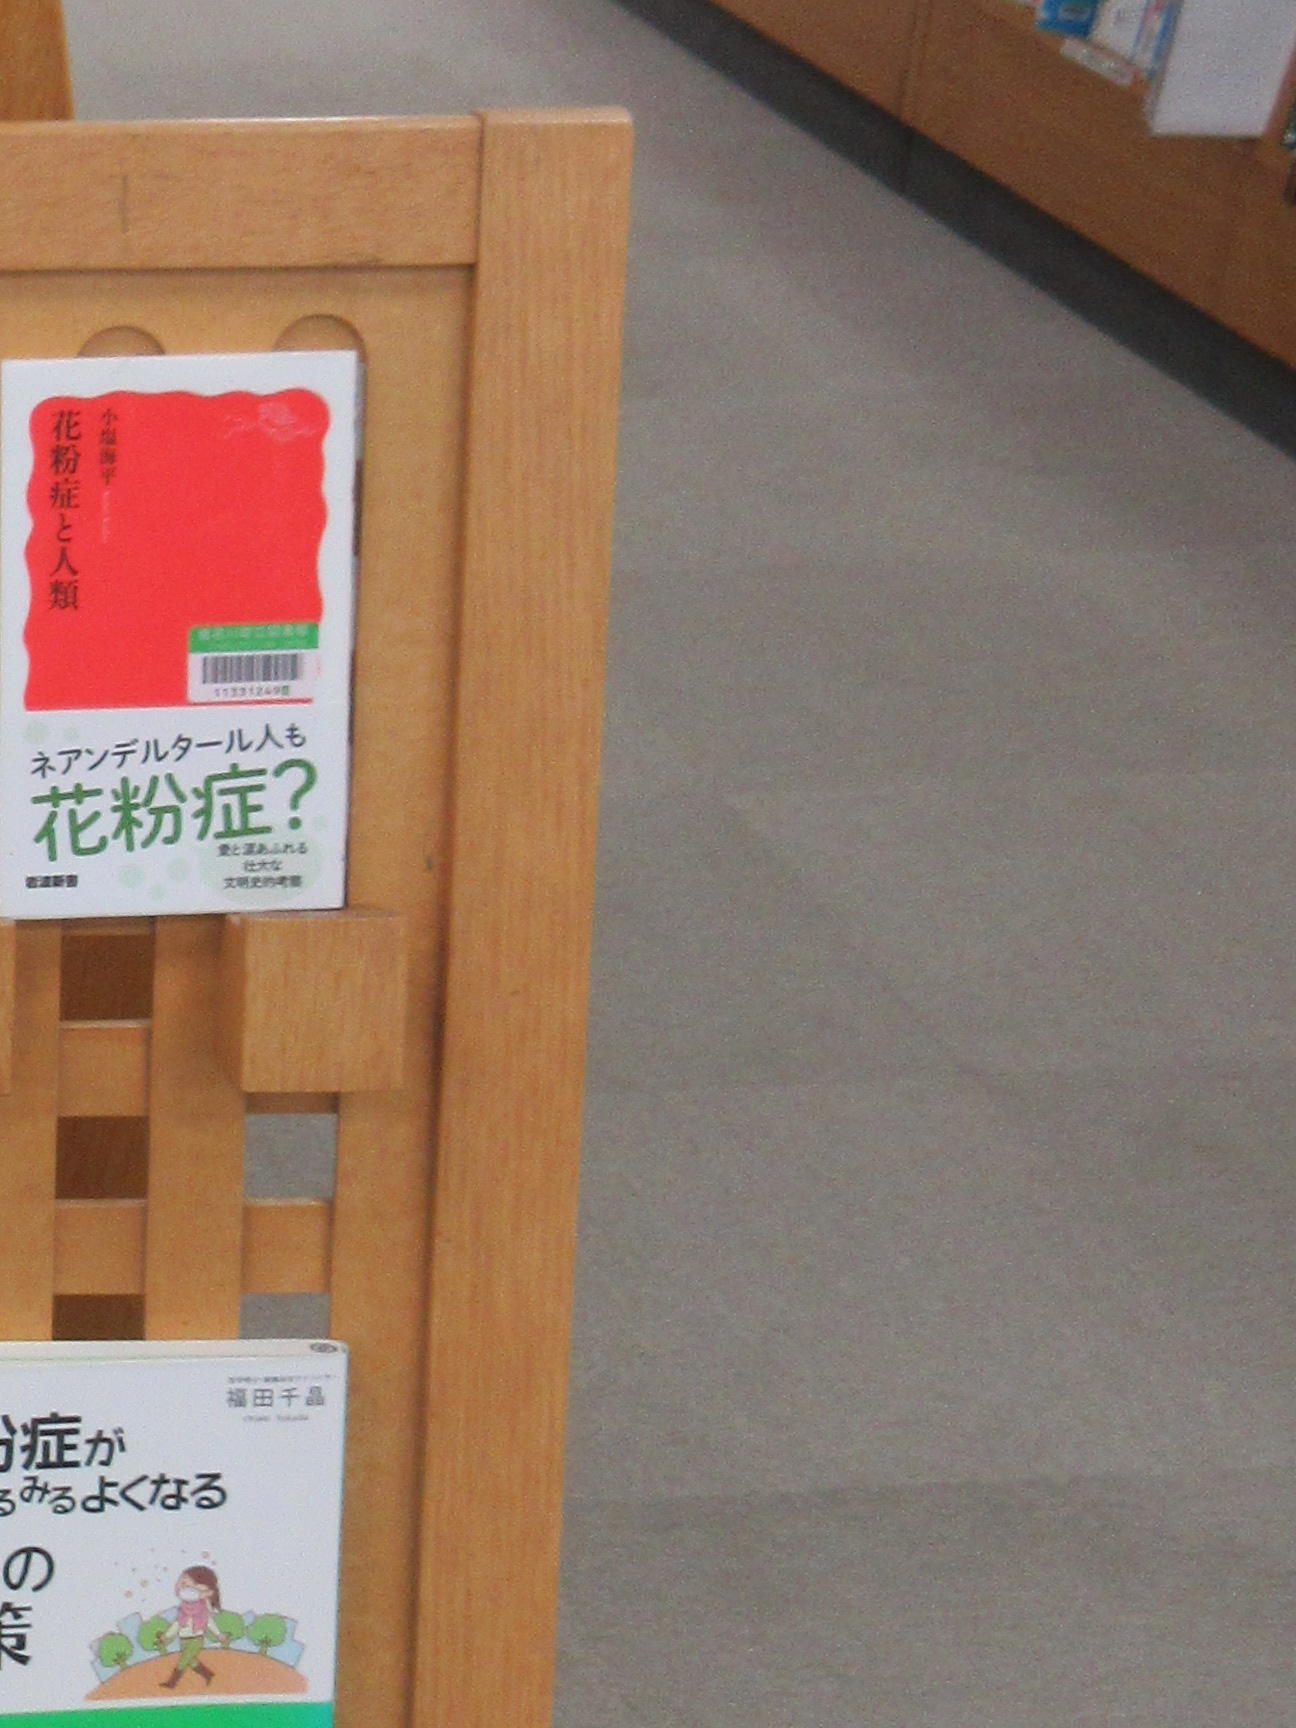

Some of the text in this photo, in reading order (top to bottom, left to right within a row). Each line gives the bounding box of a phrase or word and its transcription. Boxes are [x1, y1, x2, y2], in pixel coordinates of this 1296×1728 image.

[49, 409, 82, 610] 花粉症と人類
[31, 723, 307, 779] ネアンデルタール人も
